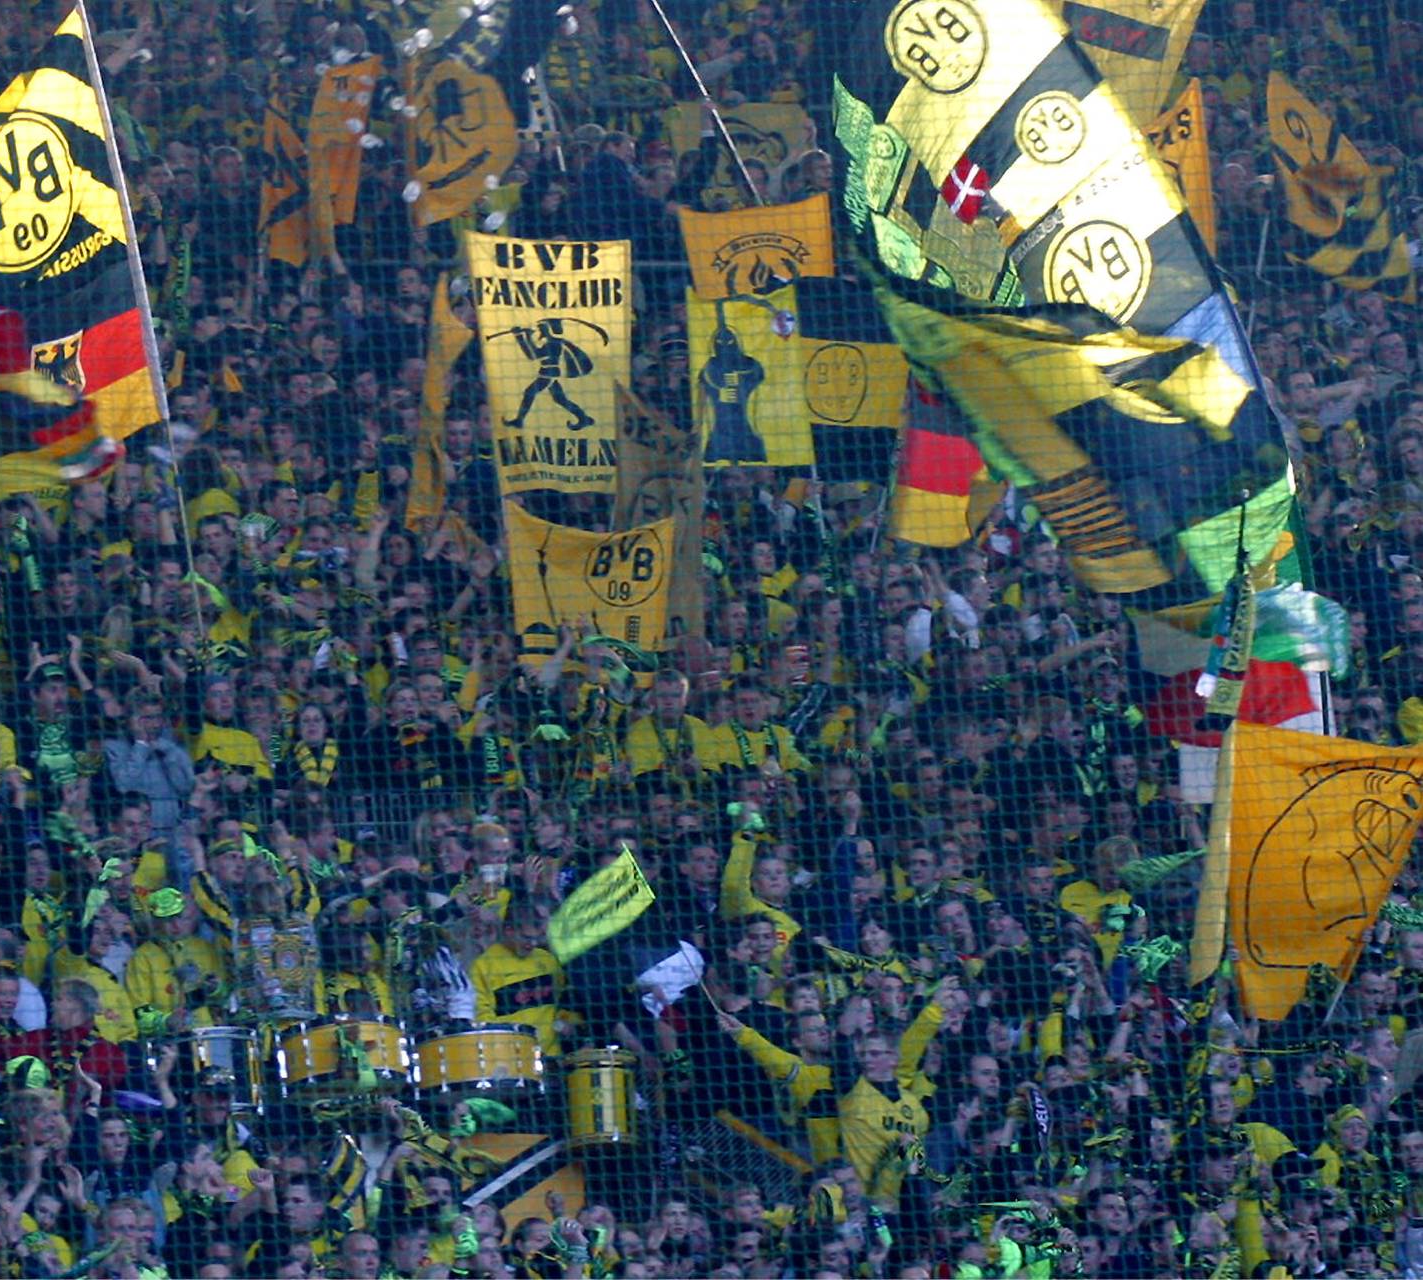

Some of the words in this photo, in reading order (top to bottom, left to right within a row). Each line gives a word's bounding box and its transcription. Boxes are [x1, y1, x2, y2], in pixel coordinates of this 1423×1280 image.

[495, 242, 599, 271] BVB
[475, 277, 623, 309] FANCLUB
[591, 534, 655, 582] BVB
[607, 580, 631, 602] 09
